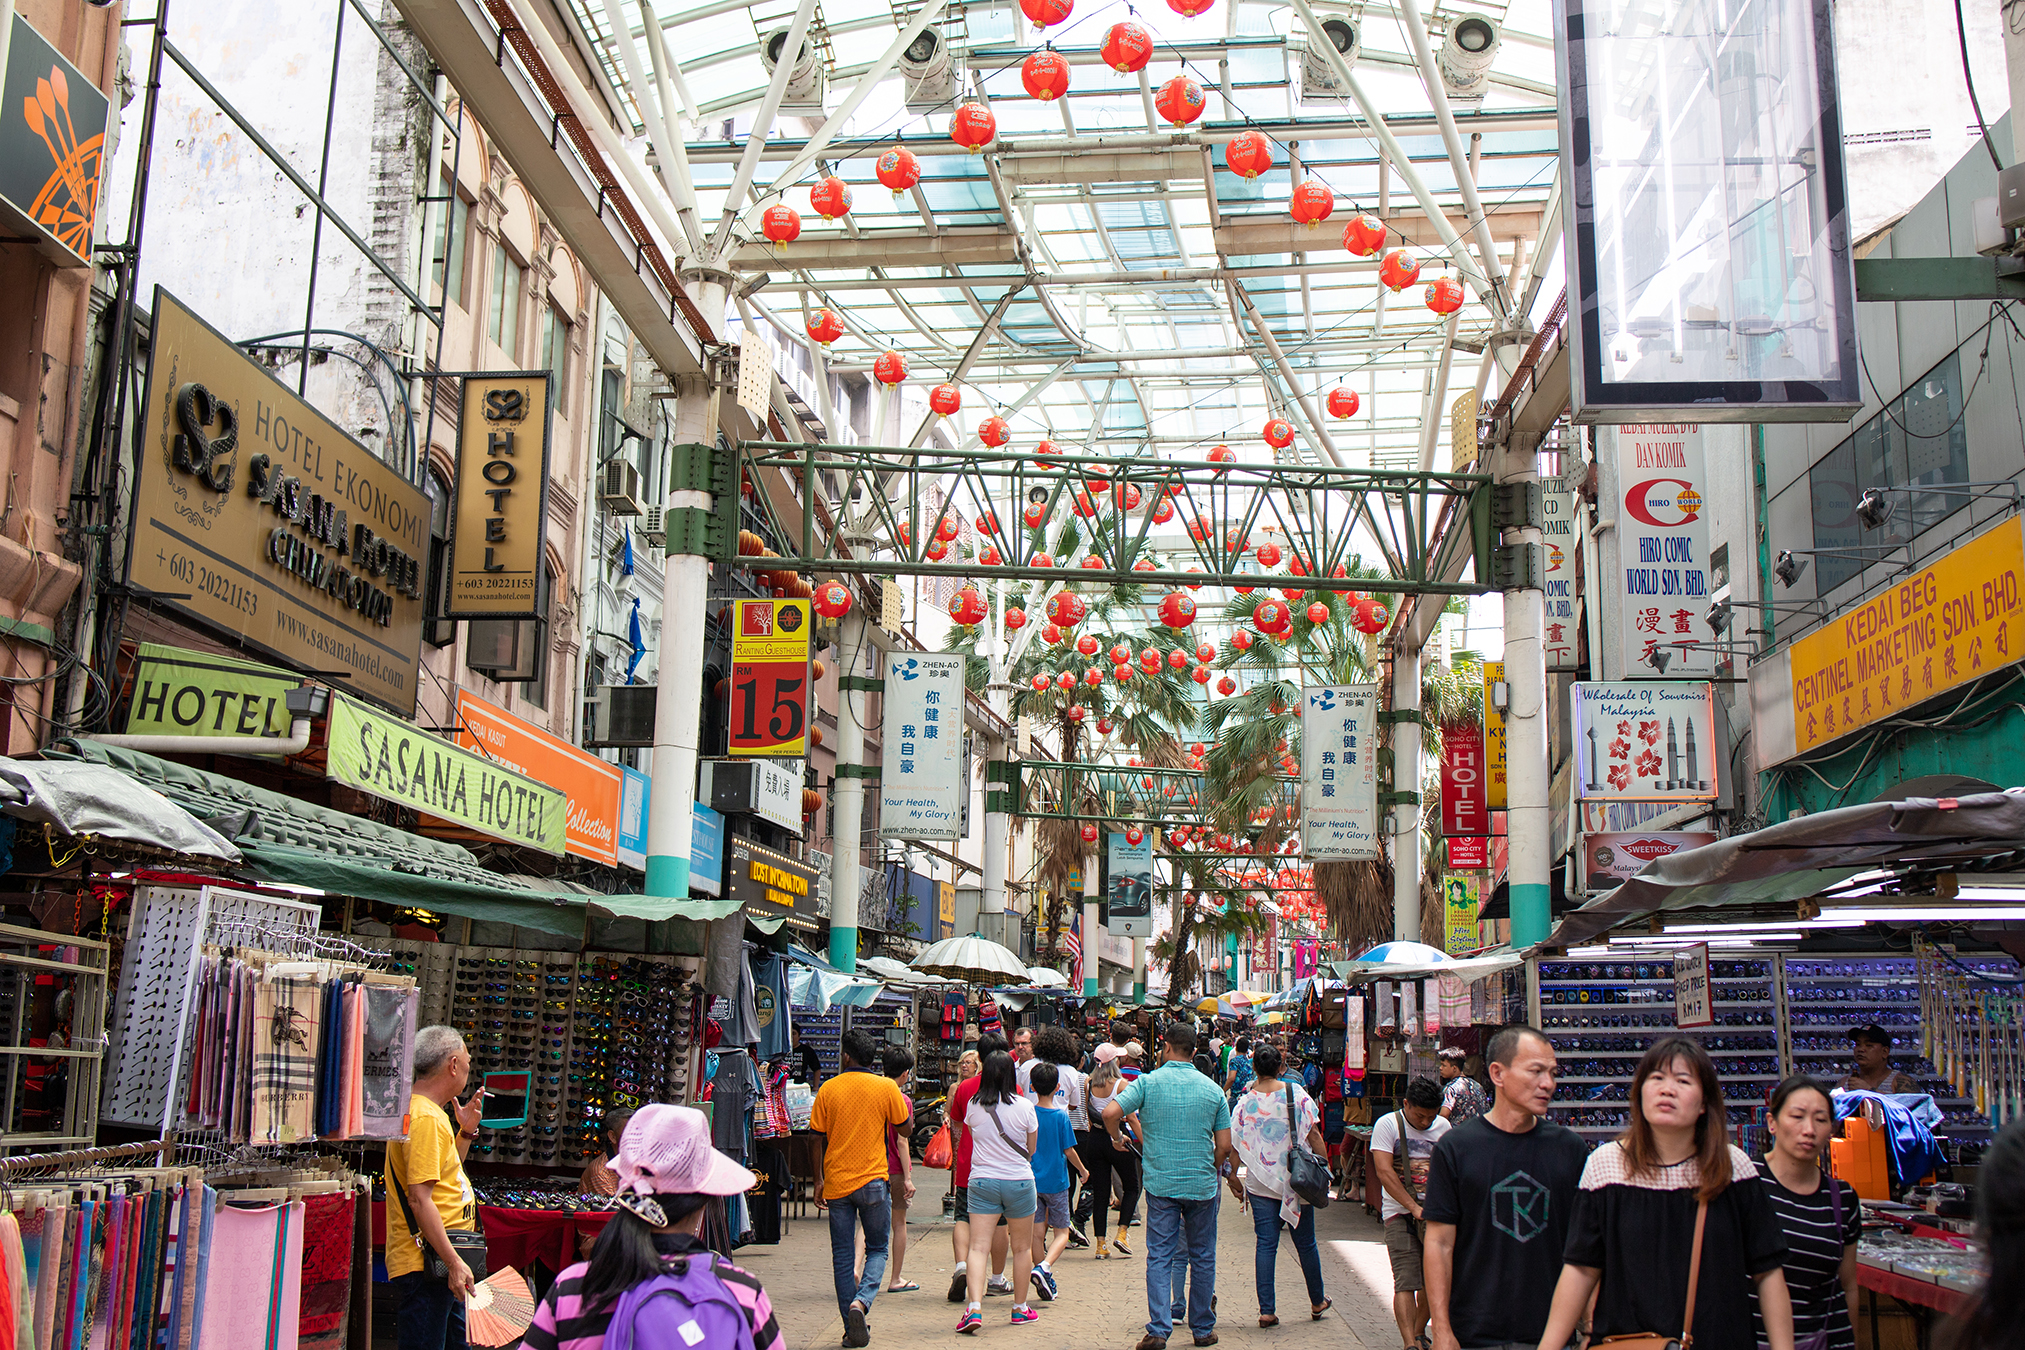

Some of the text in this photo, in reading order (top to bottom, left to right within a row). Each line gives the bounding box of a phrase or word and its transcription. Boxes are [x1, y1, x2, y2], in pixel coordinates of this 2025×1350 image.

[1636, 442, 1686, 468] DAN KOMIK
[254, 400, 423, 548] HOTEL EKONOMI
[482, 431, 517, 571] HOTEL
[1543, 500, 1558, 515] CD
[1648, 499, 1670, 507] HIRO
[248, 453, 422, 600] SASANA HOTEL
[1639, 537, 1693, 563] HIRO COMIC
[269, 527, 394, 628] CHINATOWN
[486, 578, 534, 589] 20221153
[1545, 580, 1570, 597] OMIC
[1626, 569, 1707, 596] WORLD SDN. BHD.
[199, 567, 258, 616] 20221153
[458, 592, 531, 601] www.sasanahotel.com
[1556, 600, 1573, 618] BHD.
[1845, 571, 1937, 649] KEDAI BEG
[277, 609, 404, 691] www.sasanahotel.com
[1796, 569, 2022, 713] CENTINEL MARKETING SDN. BHD.
[736, 667, 752, 675] RM
[922, 661, 959, 669] ZHEN-AO
[1583, 689, 1706, 704] Wholesale Of Souvenirs
[137, 680, 284, 738] HOTEL
[734, 678, 803, 741] 15
[923, 690, 940, 740] 你健康
[1600, 704, 1656, 720] Malaysia
[468, 719, 507, 748] KEDAI KASUT
[1343, 719, 1357, 765] 你健康
[900, 725, 916, 774] 我自豪
[358, 721, 547, 843] SASANA HOTEL
[1322, 751, 1336, 797] 我自豪
[884, 798, 939, 808] Your Health,
[1451, 752, 1477, 831] HOTEL
[566, 799, 612, 842] Collection
[909, 810, 922, 819] My
[925, 811, 949, 820] Glory
[1308, 820, 1360, 829] Your Health,
[882, 826, 957, 838] www.zhen-ao.com.my
[1332, 831, 1345, 839] My
[1347, 832, 1370, 841] Glory
[1308, 846, 1377, 856] www.zhen-ao.com.my
[1627, 845, 1672, 854] SWEETKISS
[751, 861, 769, 884] LOST
[1447, 935, 1477, 944] Styling
[1676, 975, 1705, 995] FIXED PRICE
[261, 1092, 309, 1103] BURBERRY
